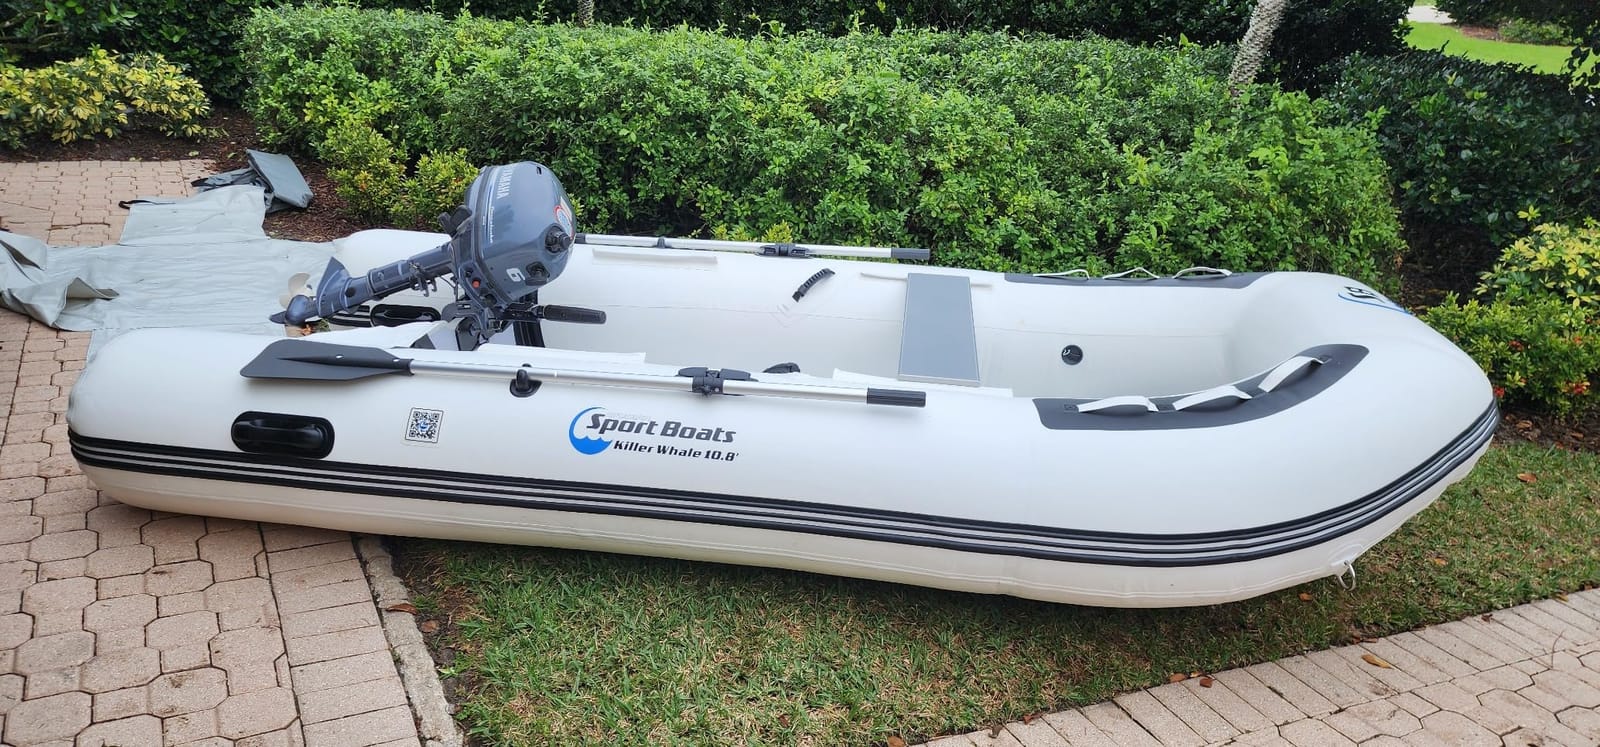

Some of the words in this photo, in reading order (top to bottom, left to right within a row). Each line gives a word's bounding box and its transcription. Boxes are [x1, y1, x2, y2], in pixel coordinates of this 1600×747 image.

[586, 413, 659, 435] Sport
[660, 421, 737, 443] Boats
[613, 440, 654, 454] Killer
[656, 445, 702, 458] Whale
[704, 449, 739, 462] 10.8'
